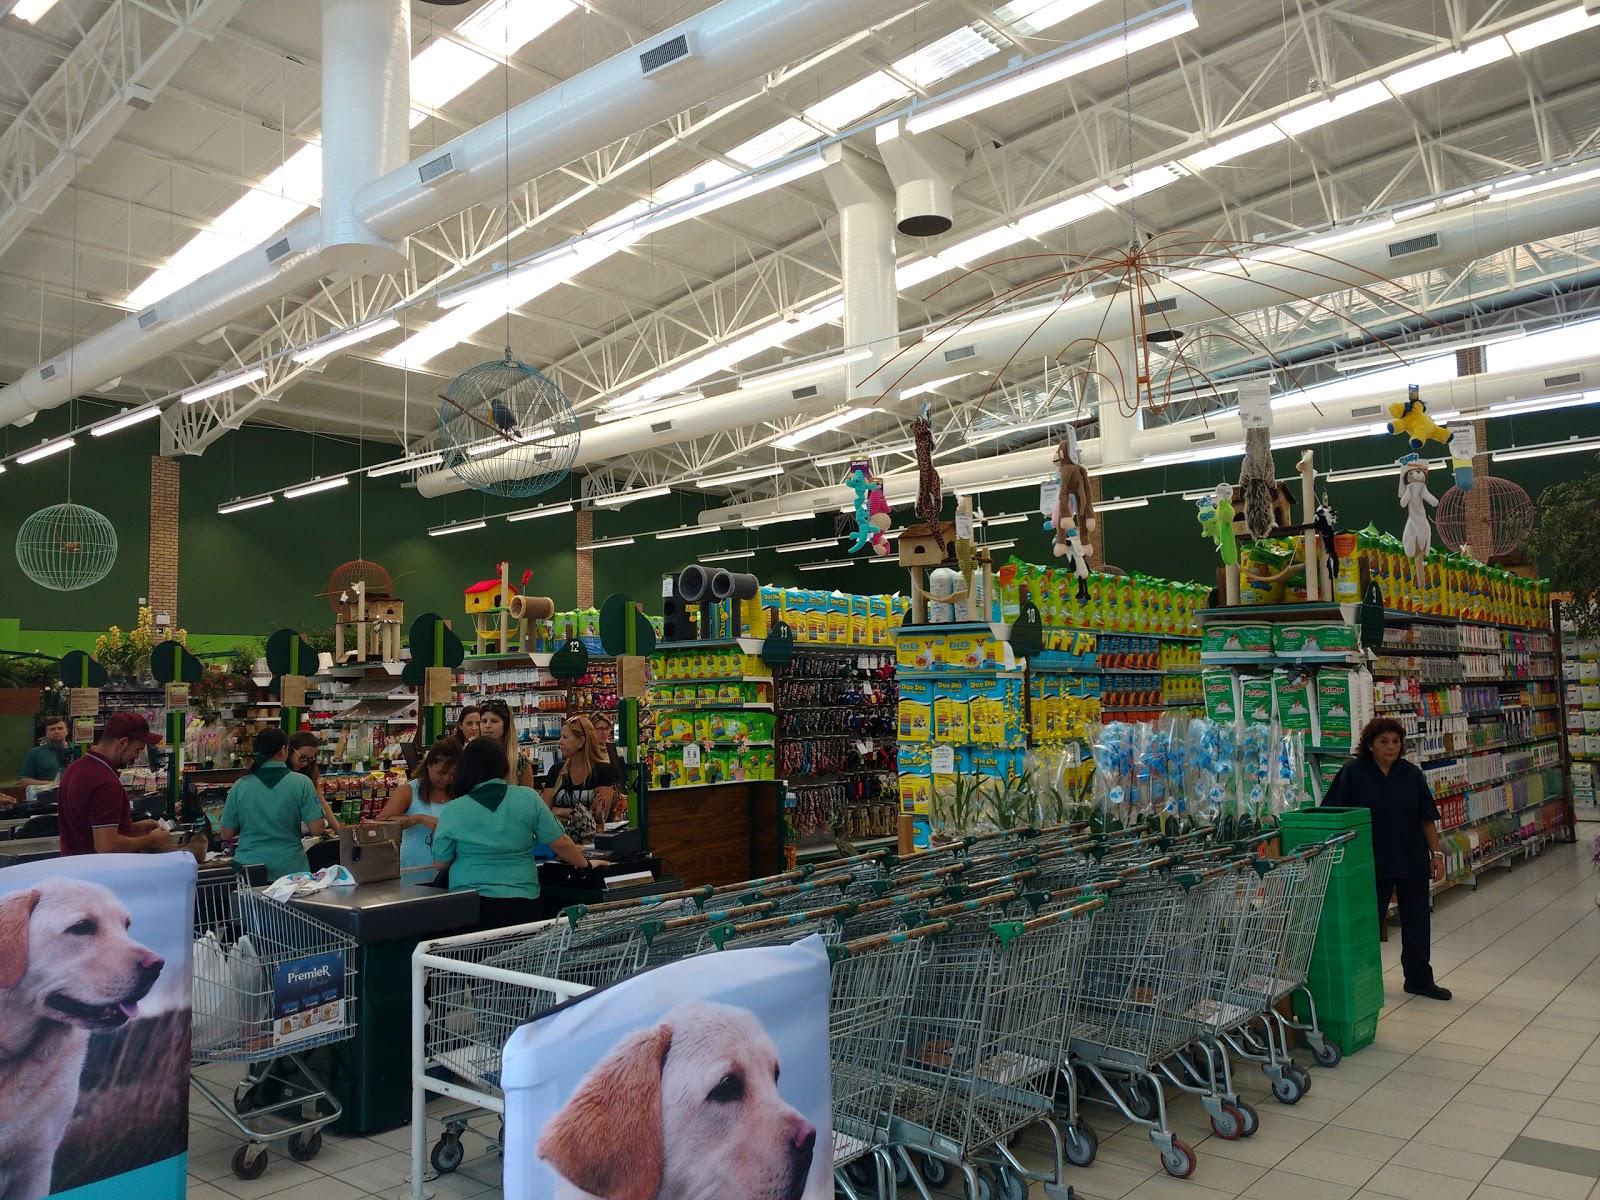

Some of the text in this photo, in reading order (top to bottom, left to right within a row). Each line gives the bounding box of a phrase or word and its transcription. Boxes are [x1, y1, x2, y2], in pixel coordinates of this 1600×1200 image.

[1372, 586, 1377, 603] 9
[1026, 608, 1036, 623] 10
[780, 625, 788, 639] 11
[569, 640, 580, 653] 12
